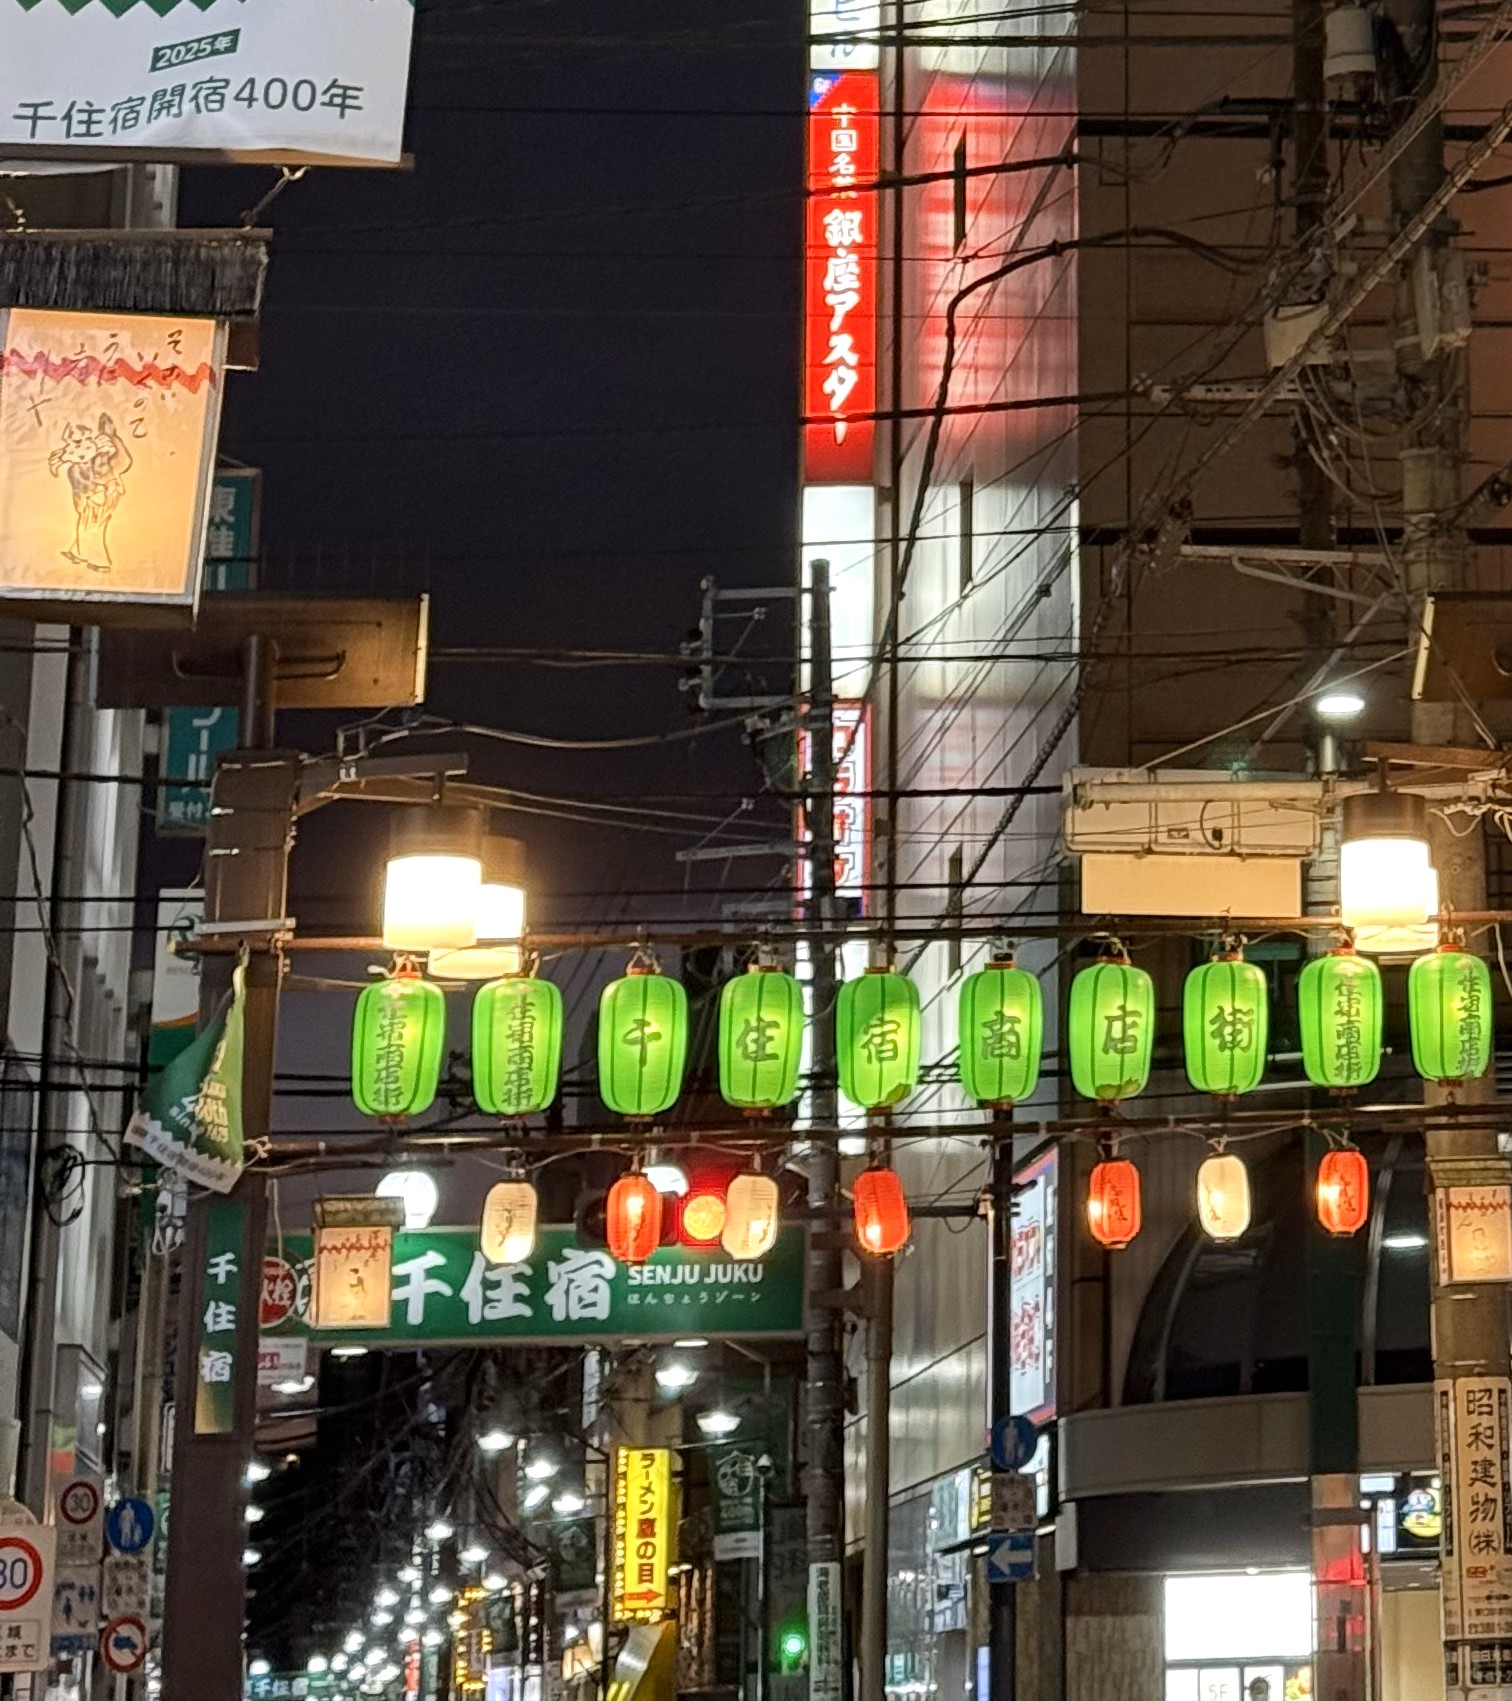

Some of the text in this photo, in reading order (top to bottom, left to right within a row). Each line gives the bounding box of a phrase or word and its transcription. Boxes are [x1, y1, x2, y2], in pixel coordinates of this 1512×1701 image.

[156, 34, 235, 68] 2025年
[11, 76, 365, 139] 千住宿開宿400年
[822, 208, 863, 446] 銀座アスター
[202, 1252, 239, 1383] 千住宿
[391, 1249, 617, 1326] 千住宿
[627, 1264, 701, 1286] SENJU
[703, 1263, 764, 1284] JUKU
[1466, 1388, 1501, 1557] 昭和建物(株)
